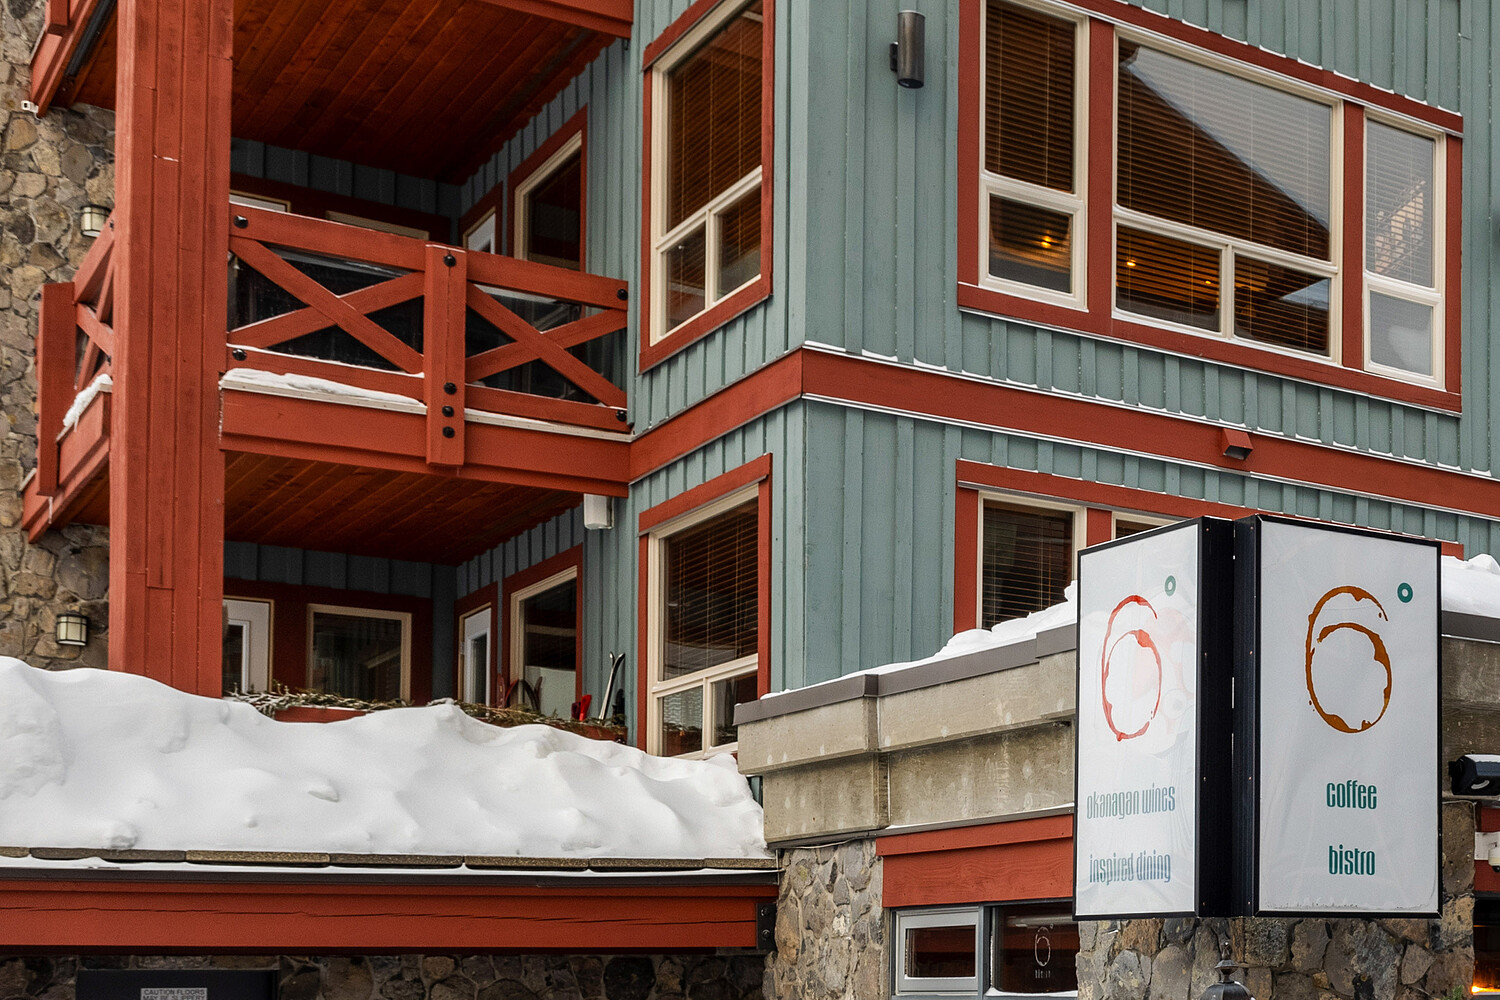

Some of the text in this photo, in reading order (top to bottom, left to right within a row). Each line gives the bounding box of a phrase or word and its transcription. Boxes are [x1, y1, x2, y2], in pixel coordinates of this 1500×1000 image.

[1086, 782, 1175, 820] okanagan wines
[1326, 780, 1377, 809] coffee
[1089, 849, 1171, 886] inspired dining
[1328, 844, 1375, 875] bistro
